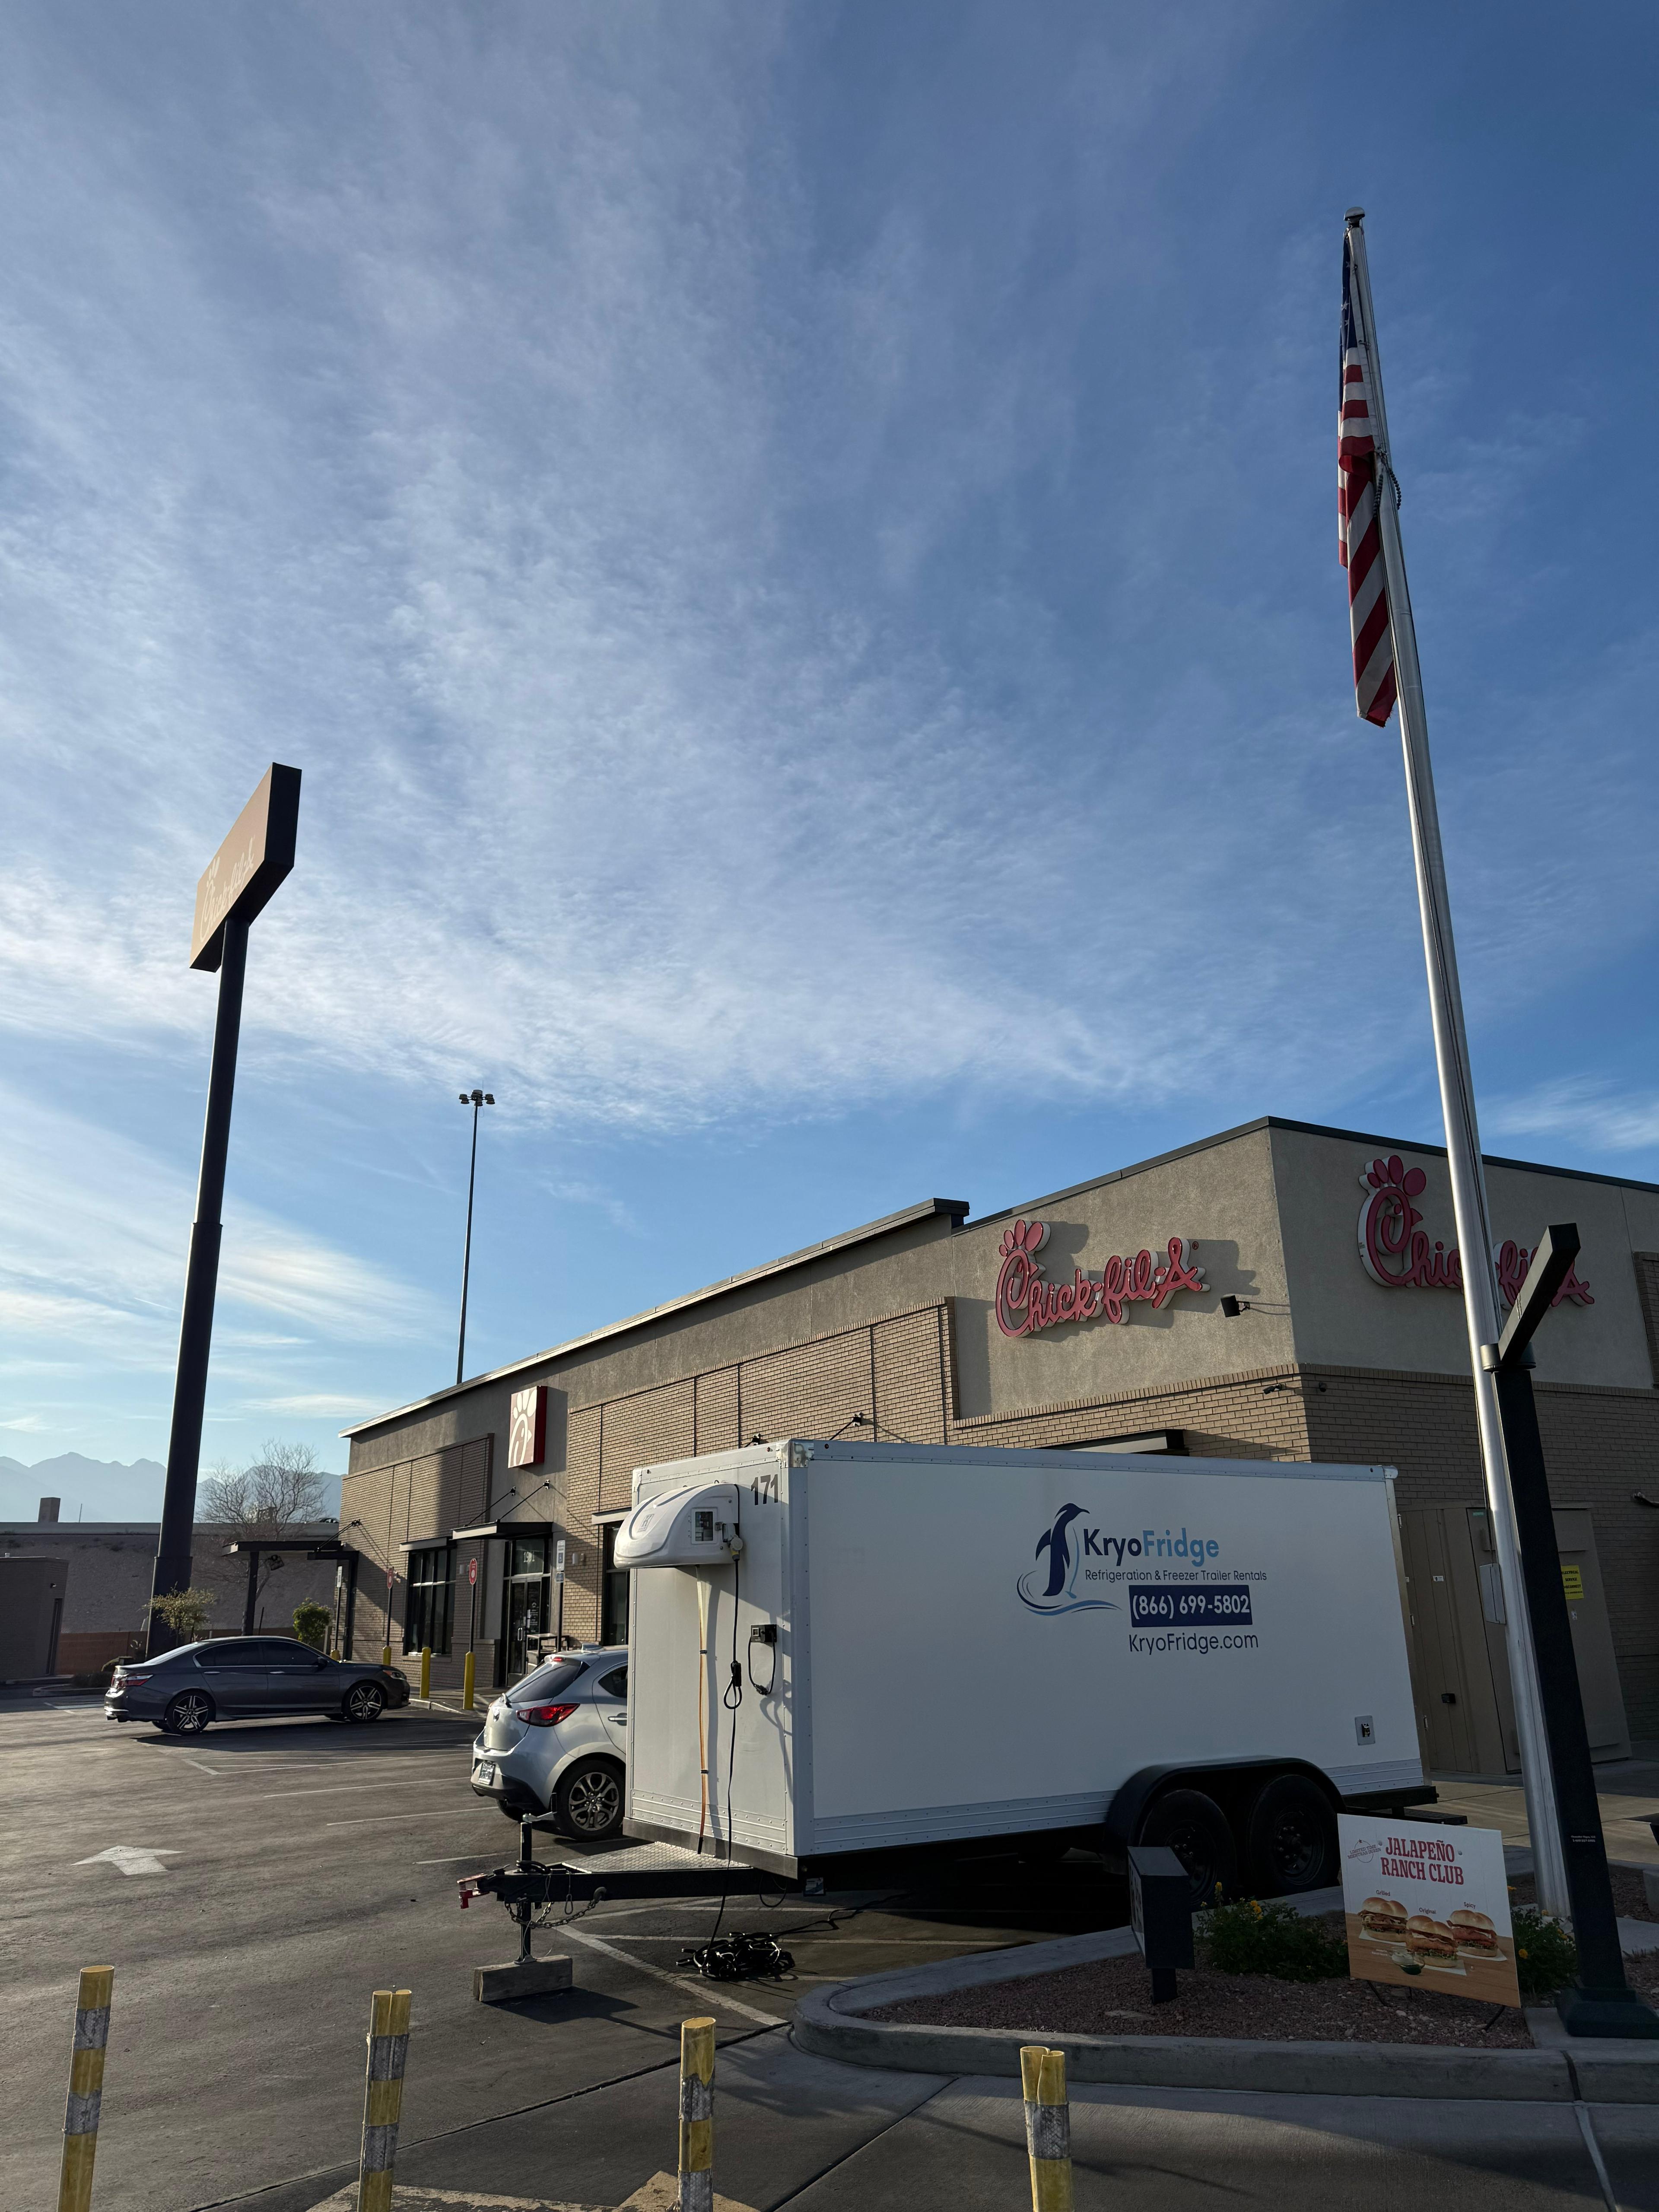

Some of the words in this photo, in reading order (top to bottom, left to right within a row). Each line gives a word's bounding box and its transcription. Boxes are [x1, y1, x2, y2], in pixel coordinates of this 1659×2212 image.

[1358, 1187, 1595, 1308] ChicfiA
[995, 1237, 1203, 1338] Chick-fil-A
[750, 1474, 779, 1505] 171
[1084, 1527, 1219, 1567] KryoFridge
[1085, 1570, 1152, 1583] Refrigeration
[1155, 1570, 1161, 1580] &
[1163, 1570, 1198, 1581] Freezer
[1201, 1570, 1231, 1580] Trailer
[1233, 1570, 1267, 1581] Rentals
[1132, 1595, 1174, 1619] (866)
[1179, 1595, 1250, 1614] 699-5802
[1129, 1633, 1259, 1655] KryoFridge.com
[1386, 1837, 1455, 1862] JALAPEÑO
[1380, 1857, 1426, 1880] RANCH
[1429, 1864, 1464, 1885] CLUB
